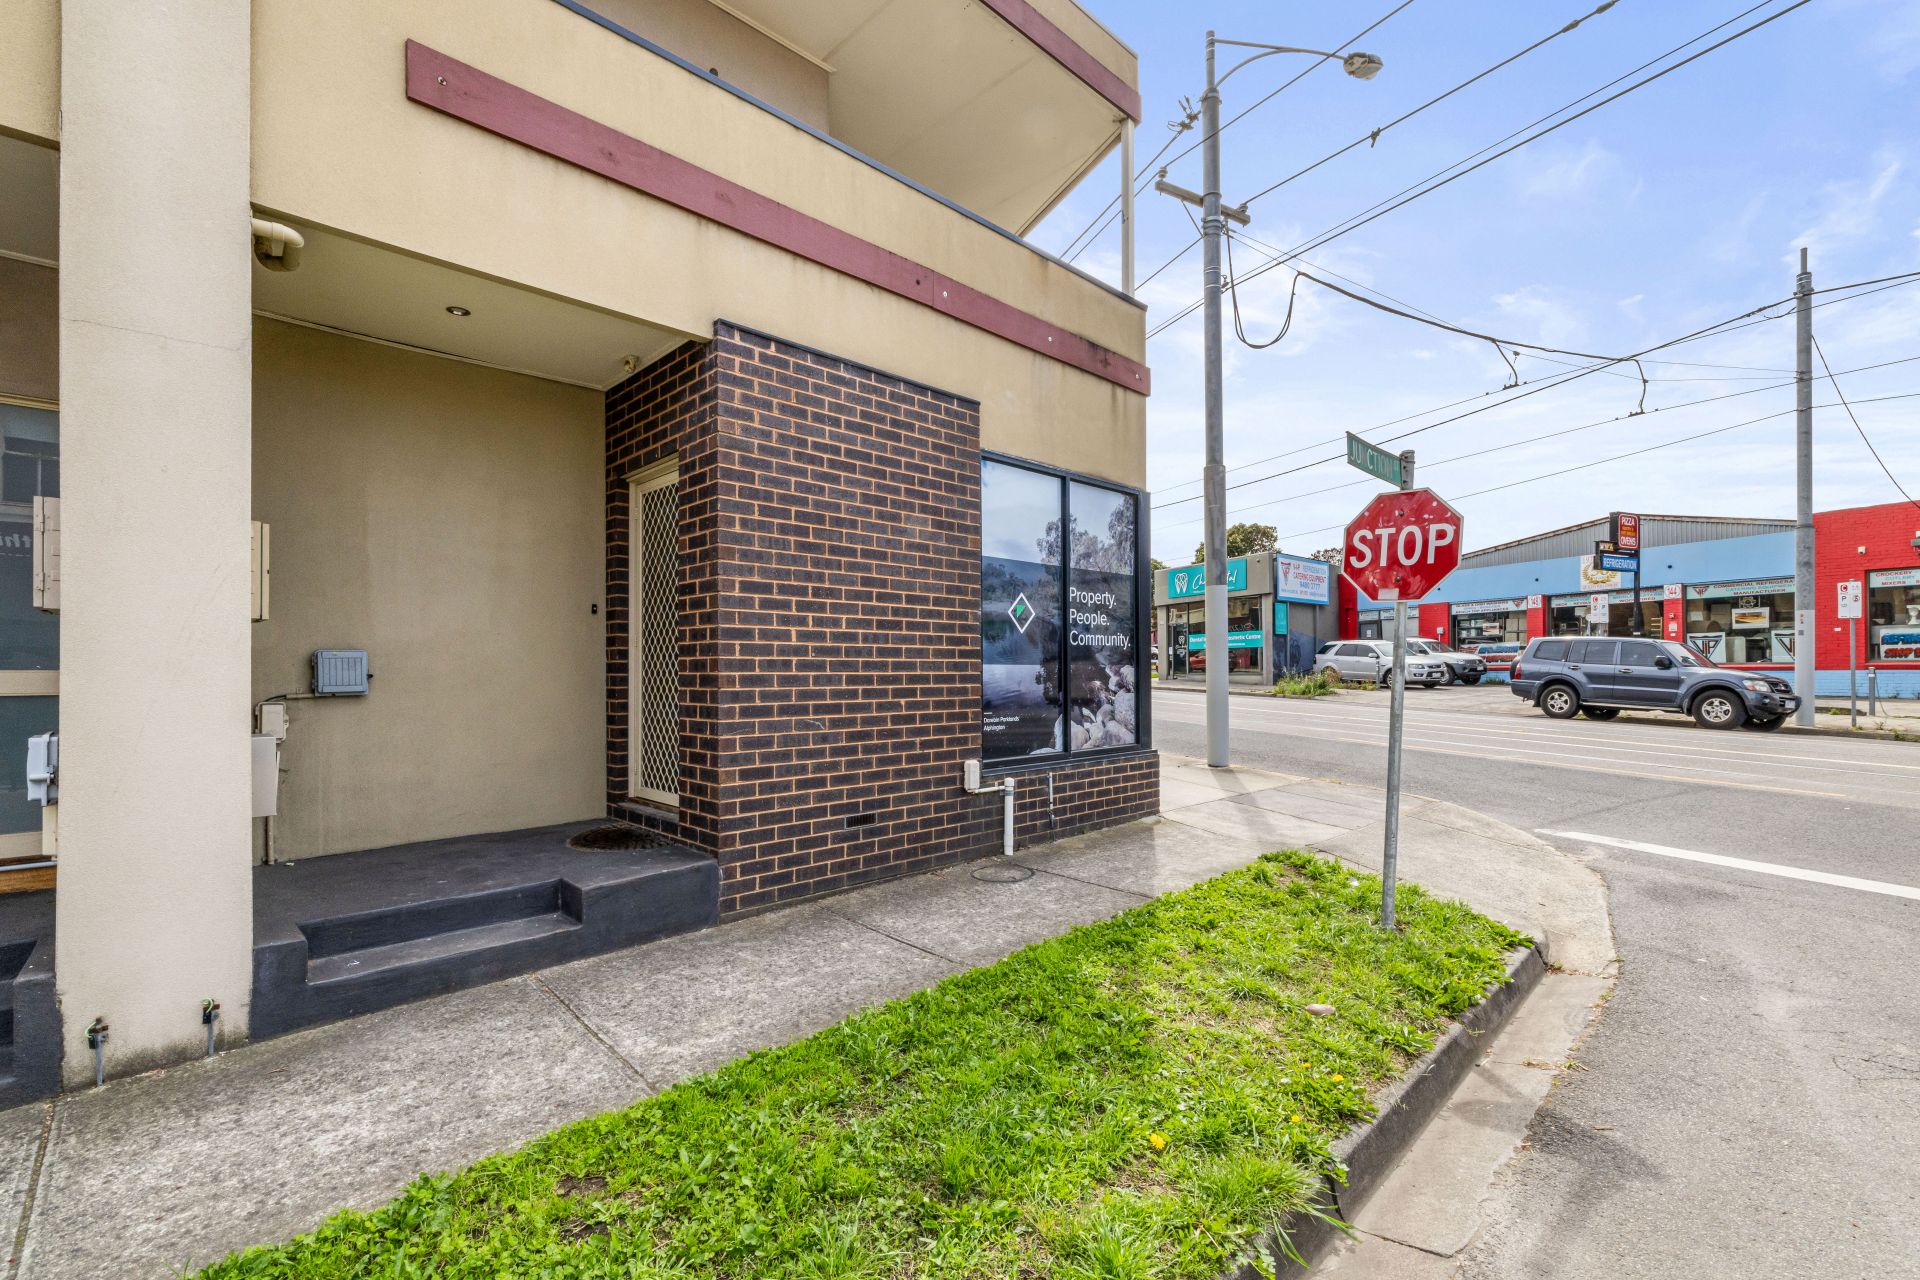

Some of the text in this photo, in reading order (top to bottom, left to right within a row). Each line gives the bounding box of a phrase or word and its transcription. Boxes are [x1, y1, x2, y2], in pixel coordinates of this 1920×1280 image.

[1350, 440, 1393, 479] JUNCTION
[1622, 517, 1634, 526] PIZZA
[1350, 523, 1454, 568] STOP
[1621, 536, 1636, 546] OVENS
[1603, 556, 1638, 569] REFRIGERATION
[1755, 579, 1793, 587] REFRIGERA
[1070, 587, 1117, 608] Property.
[1070, 608, 1110, 627] People.
[1070, 630, 1131, 650] Community.
